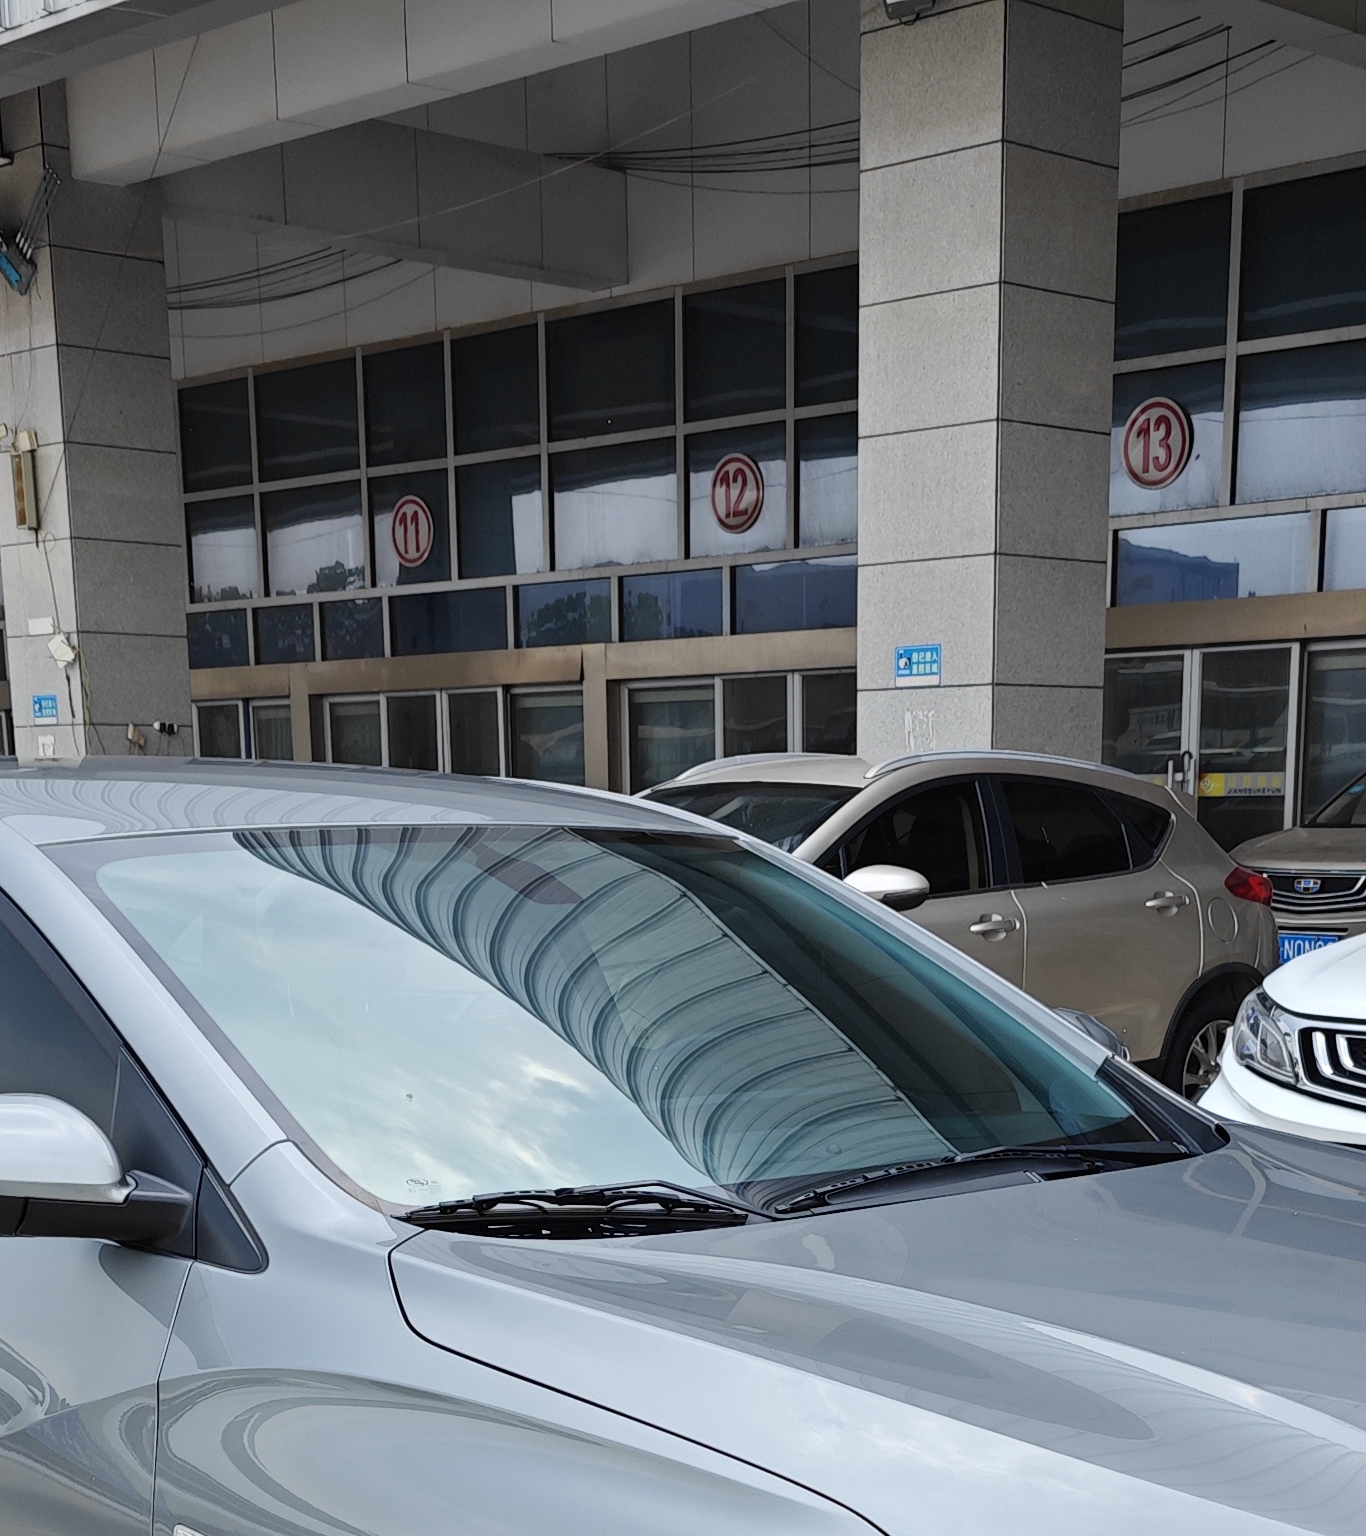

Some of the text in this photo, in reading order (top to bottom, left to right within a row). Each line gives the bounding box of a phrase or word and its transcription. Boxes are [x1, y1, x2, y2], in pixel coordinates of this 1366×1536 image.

[1136, 415, 1173, 475] 13
[719, 466, 749, 520] 12
[398, 509, 426, 554] 11
